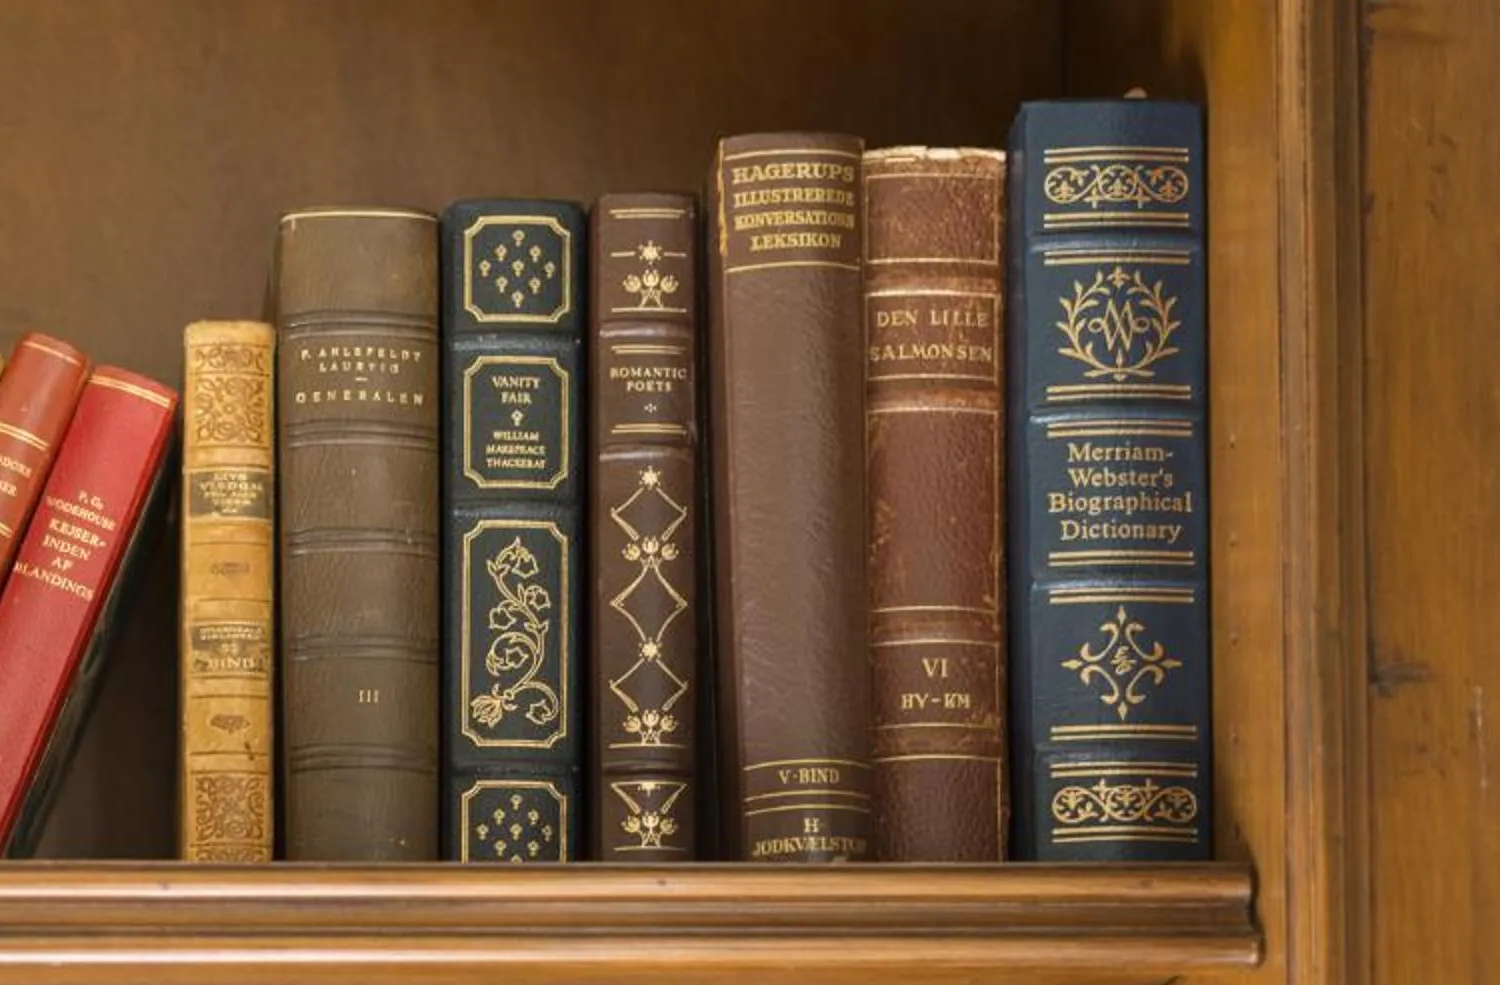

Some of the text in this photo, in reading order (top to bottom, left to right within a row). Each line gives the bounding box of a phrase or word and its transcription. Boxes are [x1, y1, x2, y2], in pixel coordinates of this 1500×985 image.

[731, 162, 854, 184] HAGERUPS
[733, 188, 854, 208] ILLUSTREREDE
[750, 232, 842, 252] LEKSIKON
[876, 308, 989, 328] DEN LILLE
[318, 347, 421, 362] AHLEFELDT
[869, 343, 992, 362] SALMONSEN
[319, 361, 400, 374] LAURVIG
[610, 366, 687, 379] ROMANTIC
[492, 376, 540, 389] VANITY
[626, 380, 673, 392] POETS
[295, 389, 424, 406] GENERALEN
[501, 391, 533, 405] FAIR
[493, 431, 540, 442] WILLIAM
[485, 444, 546, 456] MAKEPEACE
[1068, 443, 1174, 462] Merriam-
[485, 458, 546, 470] THACKERAY
[1070, 468, 1173, 487] Webster's
[78, 490, 88, 504] P.
[1048, 492, 1193, 516] Biographical
[1060, 520, 1182, 543] Dictionary
[42, 535, 92, 561] INDEN
[52, 556, 75, 571] AF
[15, 561, 95, 602] BLANDINGS
[921, 658, 948, 678] VI
